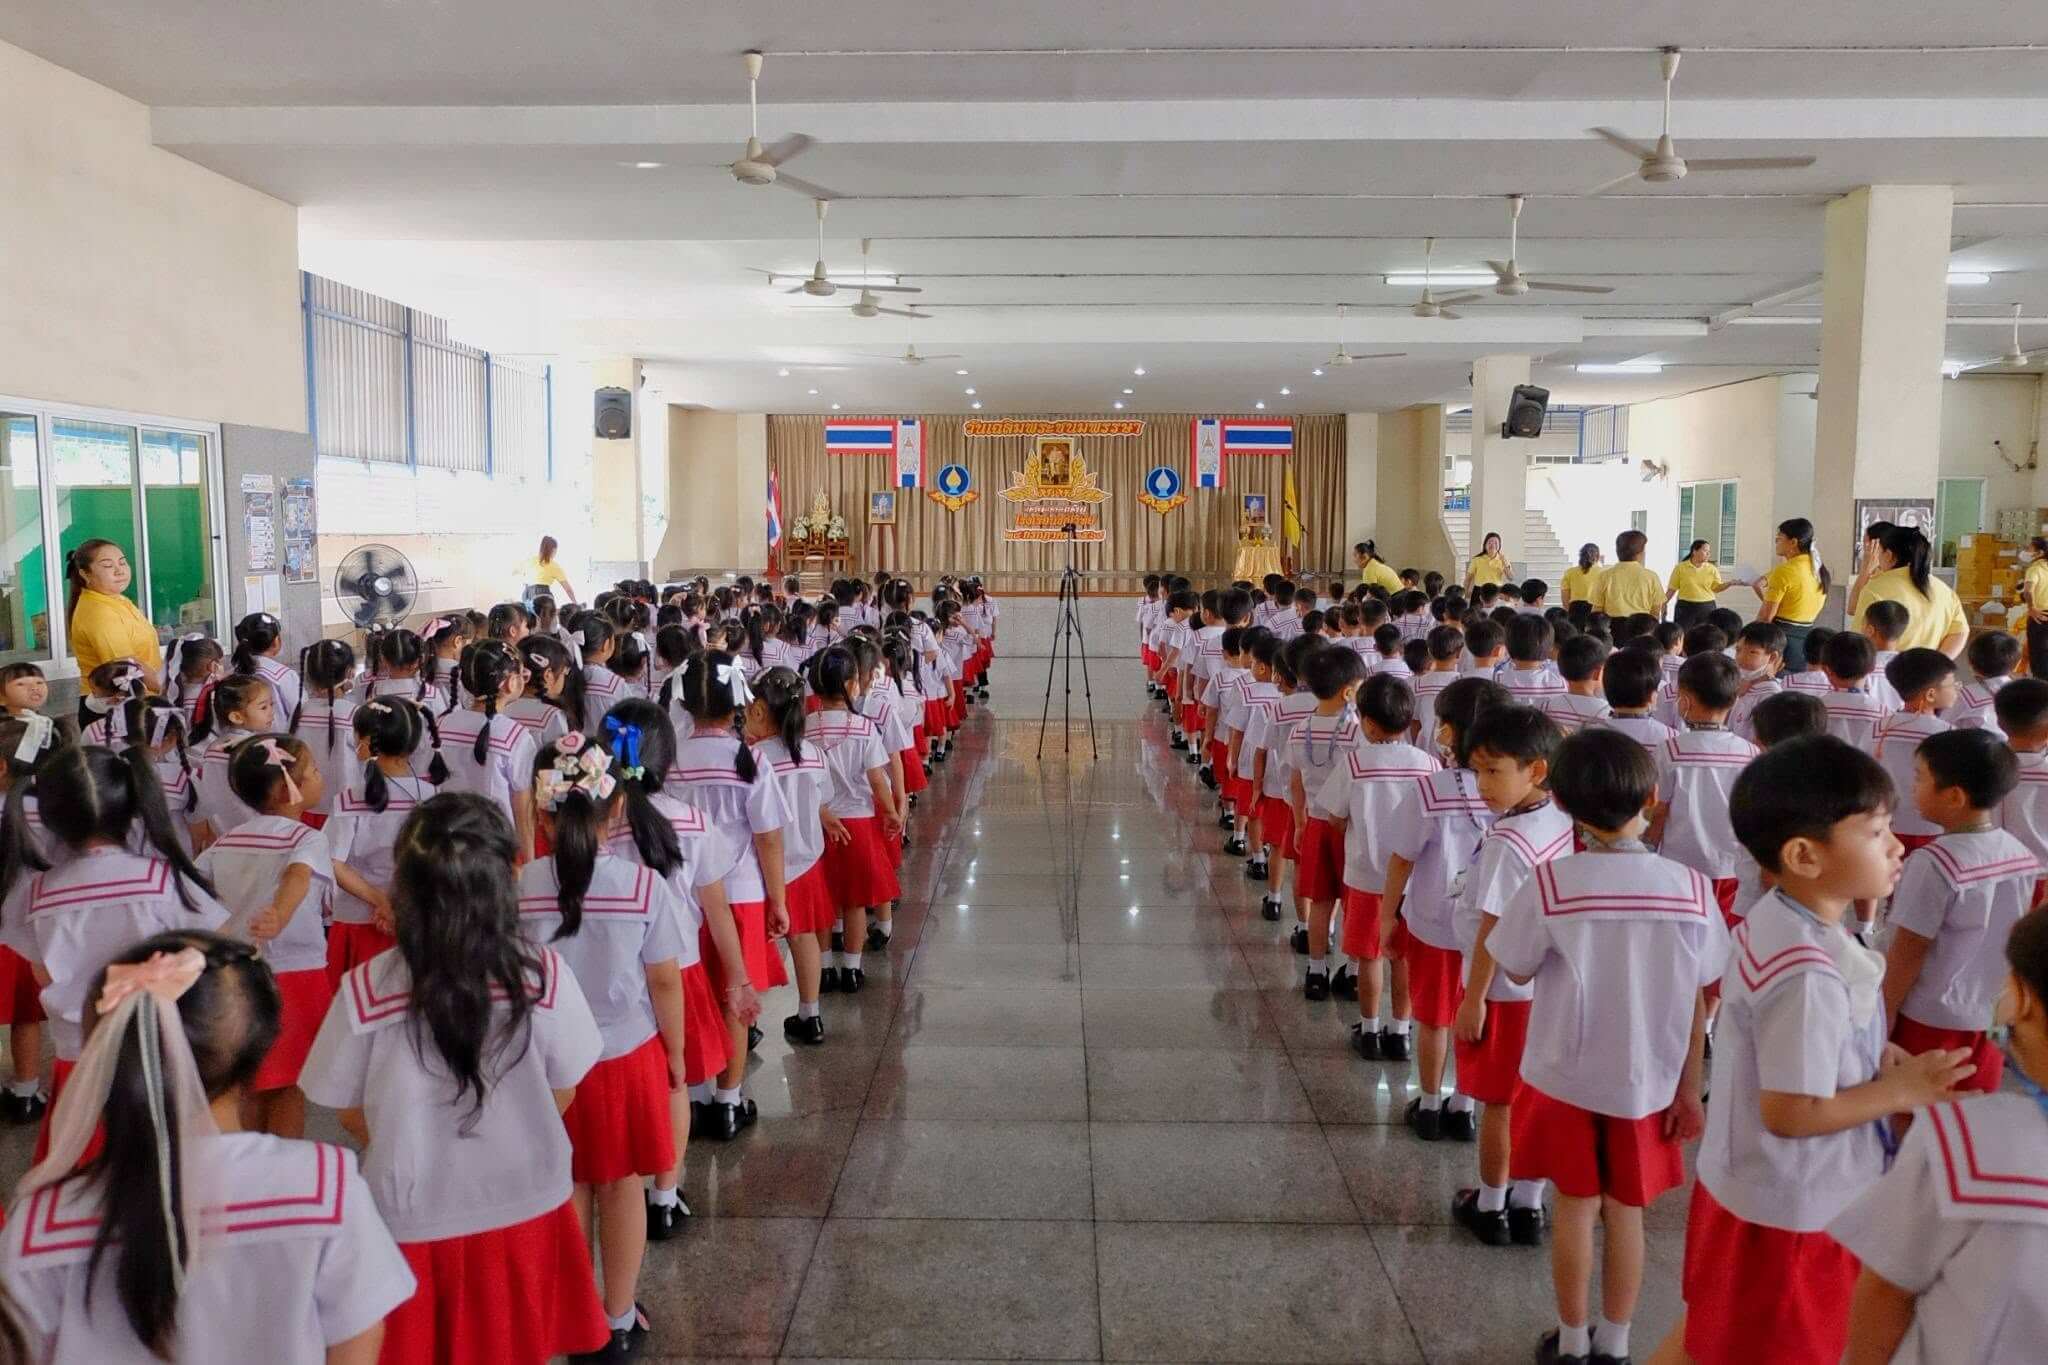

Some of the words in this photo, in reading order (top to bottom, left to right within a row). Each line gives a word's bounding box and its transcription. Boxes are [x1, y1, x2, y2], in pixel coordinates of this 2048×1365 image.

[966, 419, 1143, 435] วันเฉลิมพระชนมพรรษา
